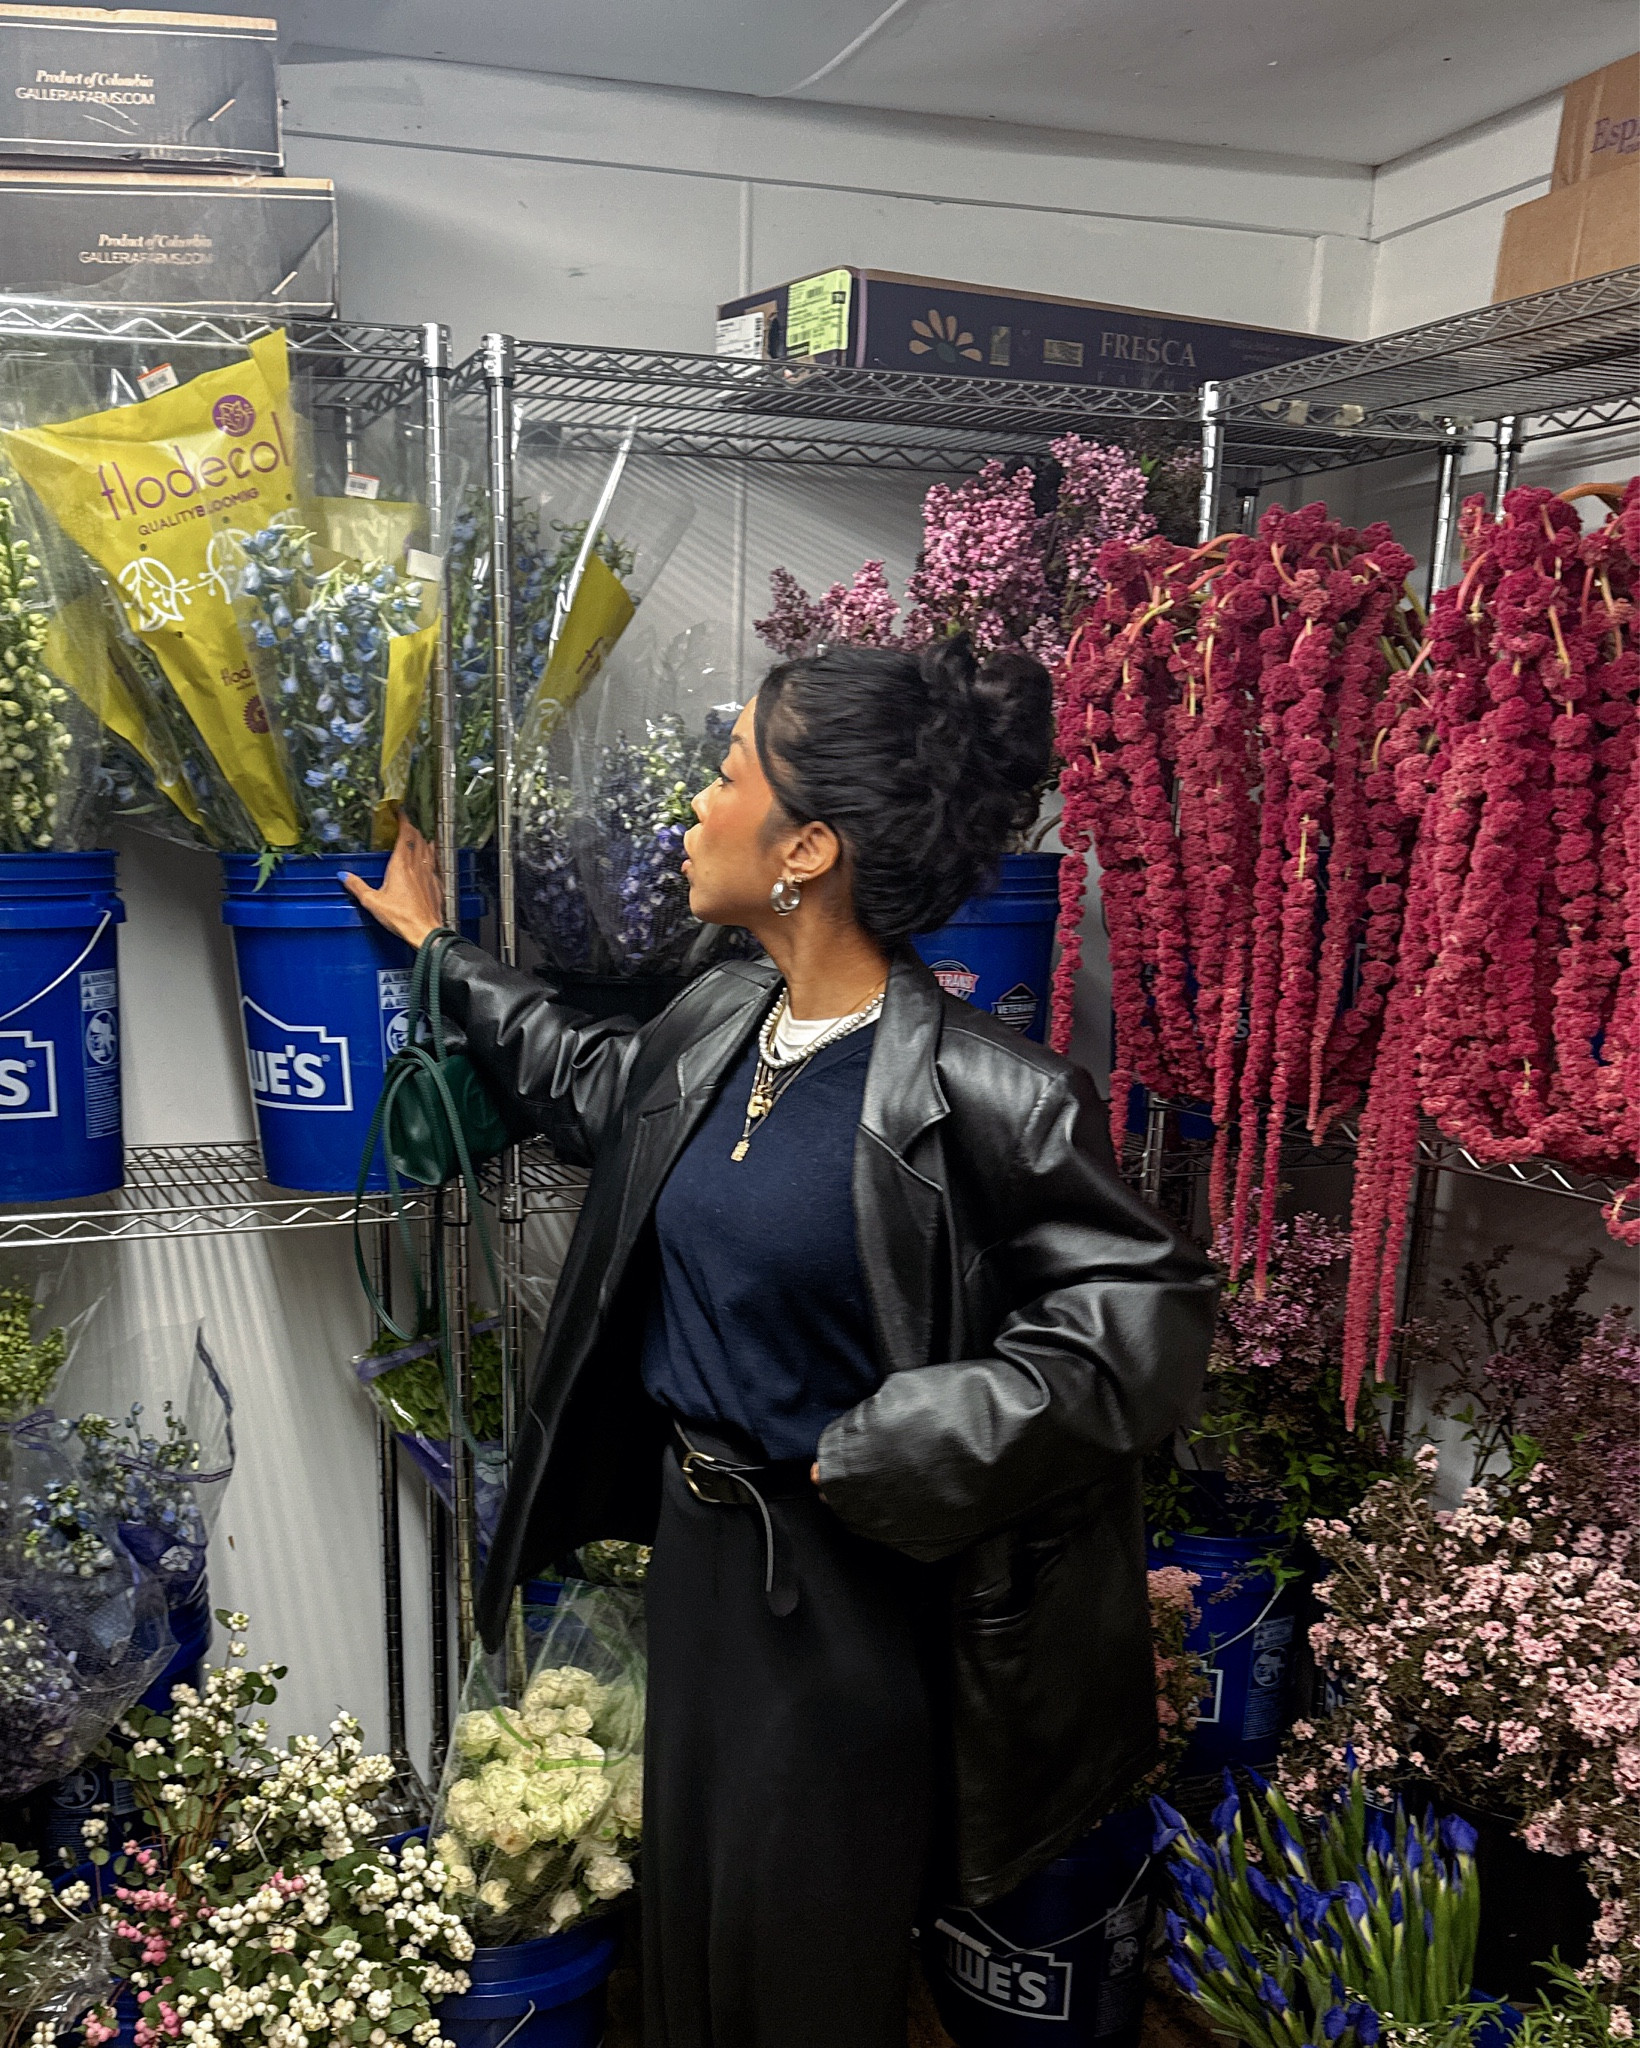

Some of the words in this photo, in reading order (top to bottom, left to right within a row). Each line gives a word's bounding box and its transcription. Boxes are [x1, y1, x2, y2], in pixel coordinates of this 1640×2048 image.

[35, 69, 82, 85] Product
[84, 71, 100, 89] of
[1589, 116, 1639, 154] Esp
[1099, 331, 1197, 368] FRESCA
